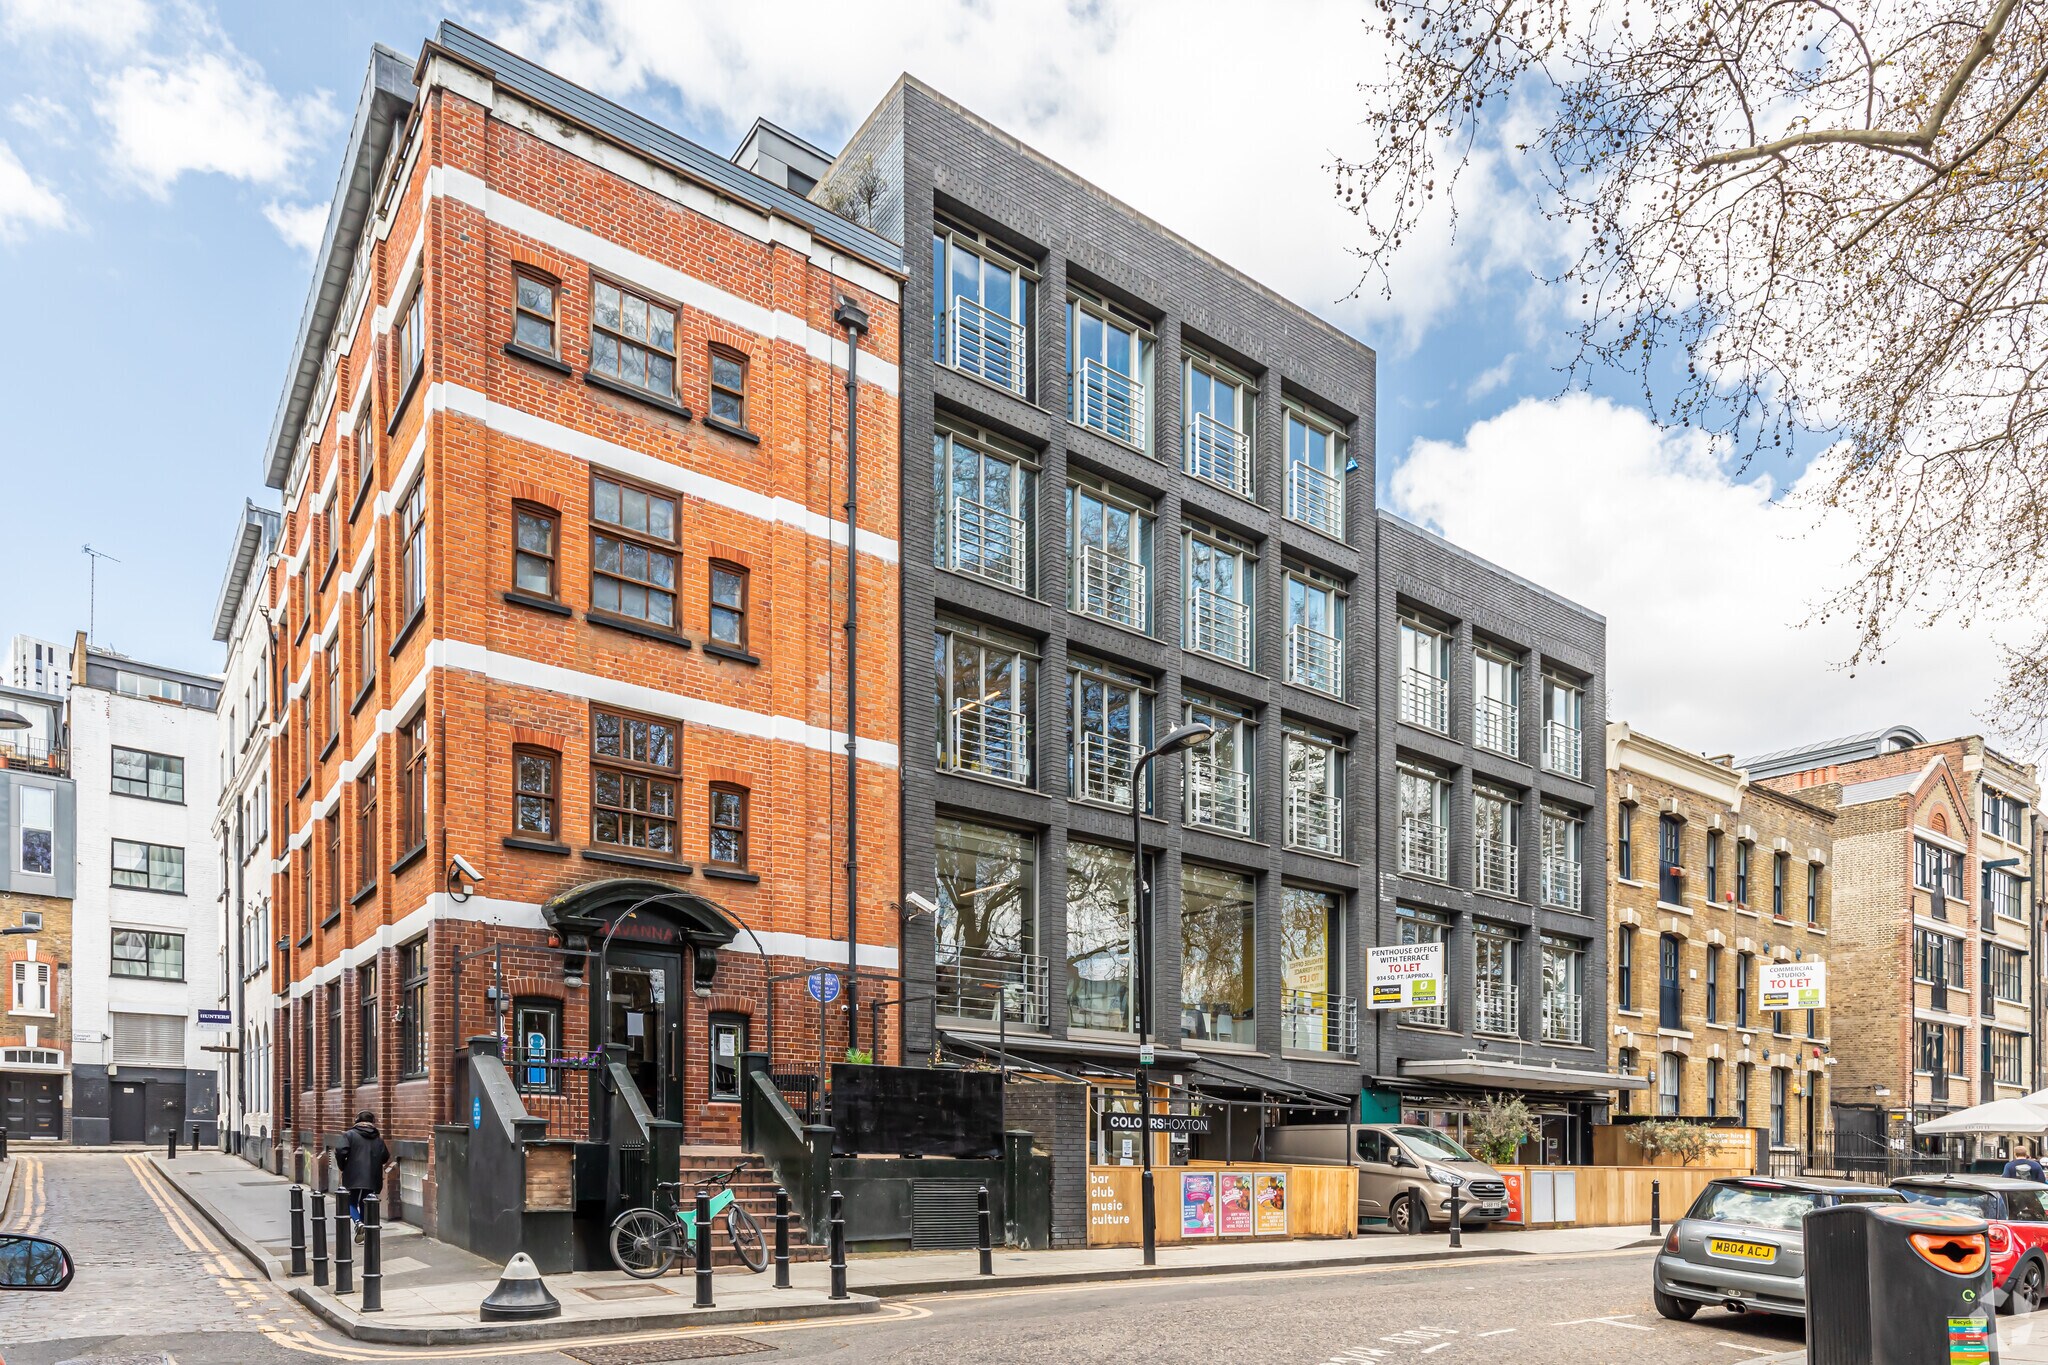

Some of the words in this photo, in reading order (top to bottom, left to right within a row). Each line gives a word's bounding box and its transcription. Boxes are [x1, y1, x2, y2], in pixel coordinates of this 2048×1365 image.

[1372, 948, 1412, 956] PENTHOUSE
[1399, 954, 1429, 962] TERRACE
[1388, 964, 1401, 973] TO
[1403, 963, 1421, 972] LET
[1770, 979, 1786, 988] TO
[1789, 978, 1811, 988] LET
[1110, 1116, 1208, 1131] COLORSHOXTON
[1091, 1172, 1109, 1184] bar
[1091, 1186, 1114, 1198] club
[1091, 1199, 1123, 1211] music
[1091, 1214, 1130, 1225] culture
[1716, 1242, 1744, 1253] MB04
[1747, 1248, 1770, 1257] ACJ
